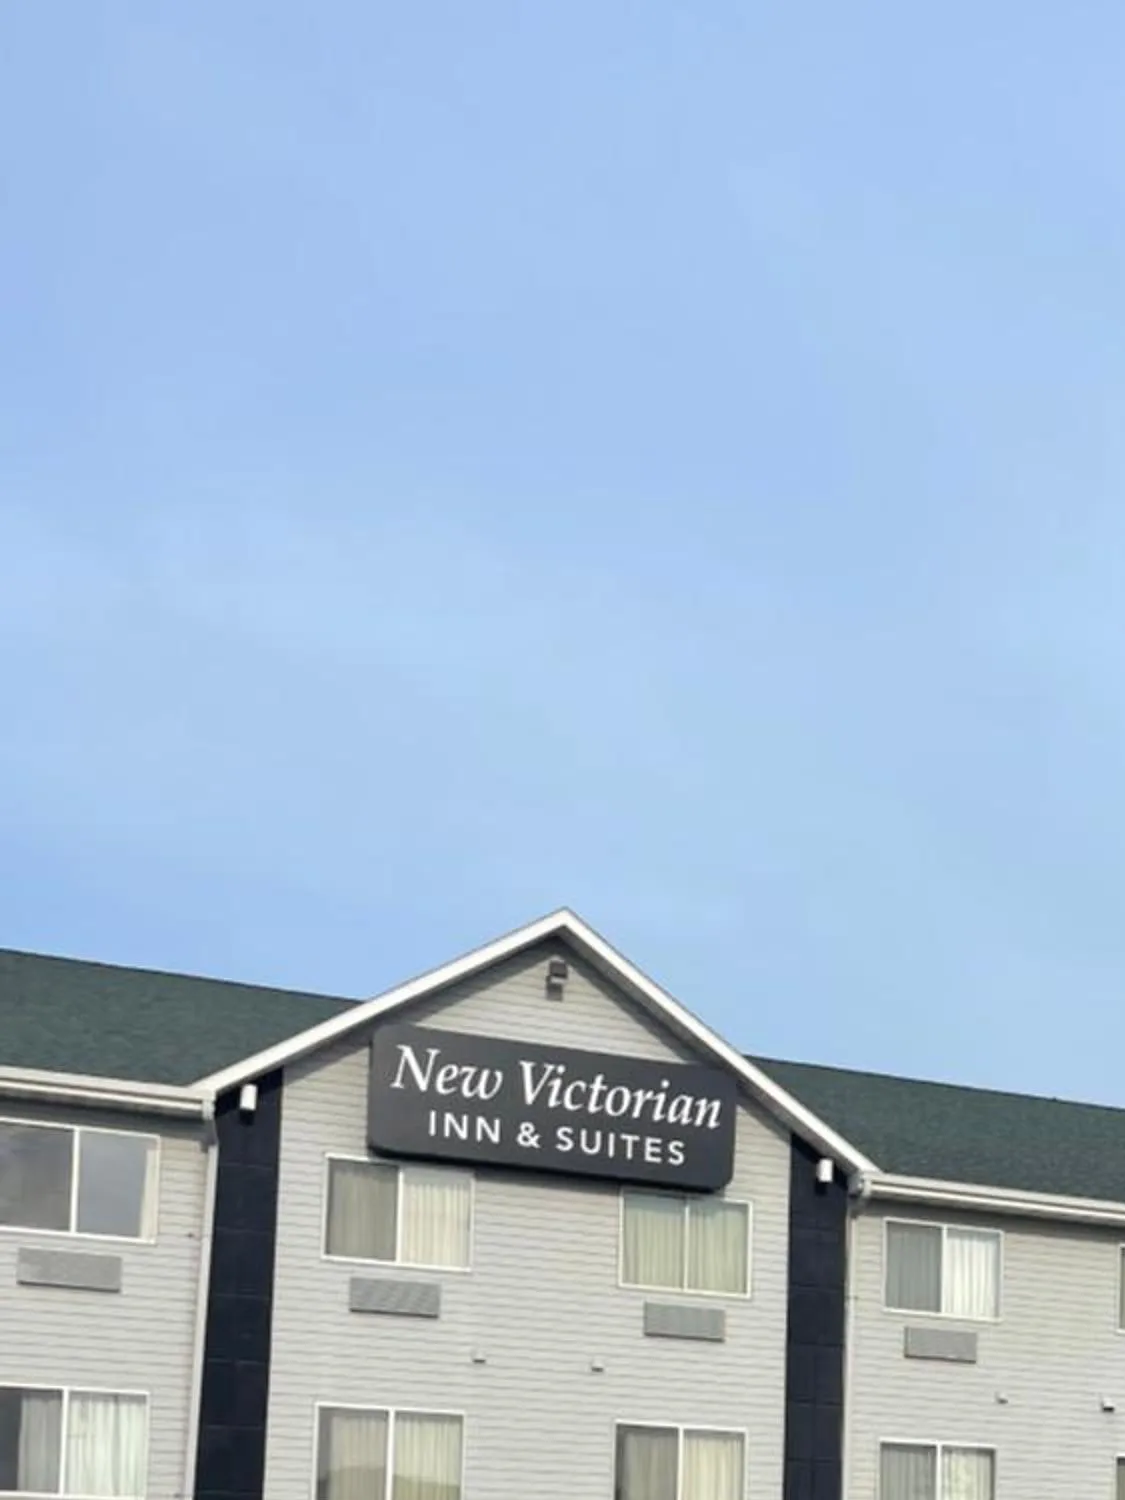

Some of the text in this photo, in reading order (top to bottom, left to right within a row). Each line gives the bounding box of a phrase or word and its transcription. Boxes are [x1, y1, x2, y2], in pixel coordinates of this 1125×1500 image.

[390, 1044, 721, 1130] New Victorian
[428, 1110, 685, 1166] INN & SUITES
